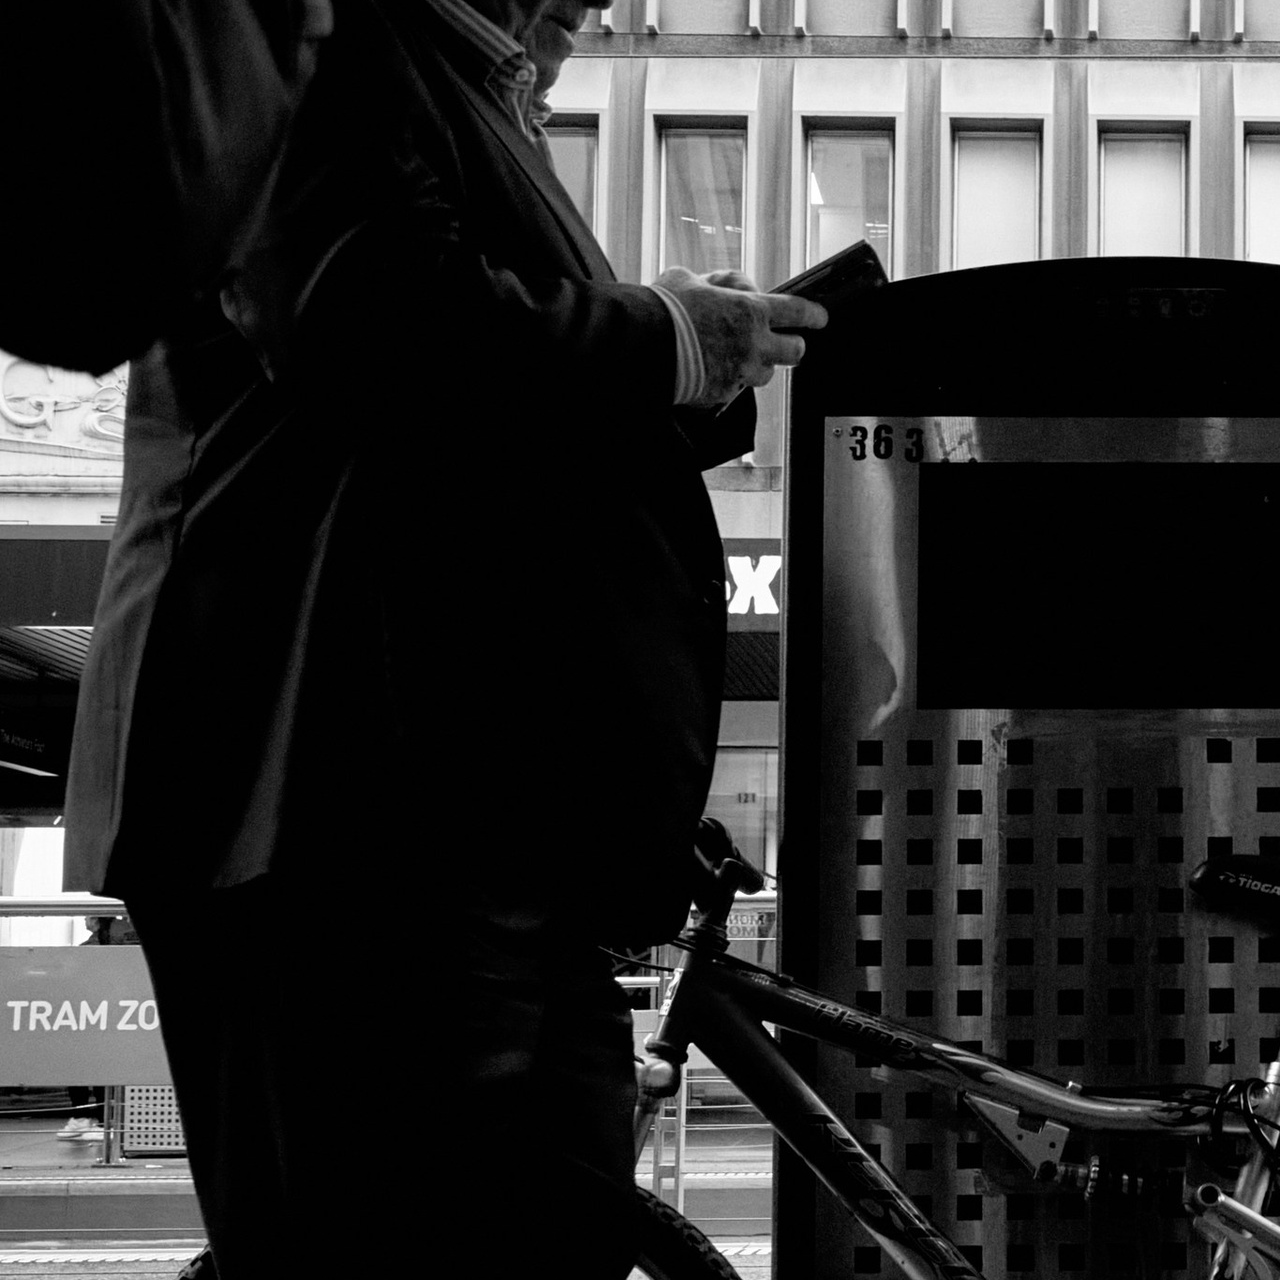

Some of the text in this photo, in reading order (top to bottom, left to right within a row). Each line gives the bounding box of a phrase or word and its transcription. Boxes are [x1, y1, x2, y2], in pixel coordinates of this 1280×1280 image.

[725, 554, 783, 616] X
[6, 999, 109, 1031] TRAM
[813, 1000, 917, 1056] Flame
